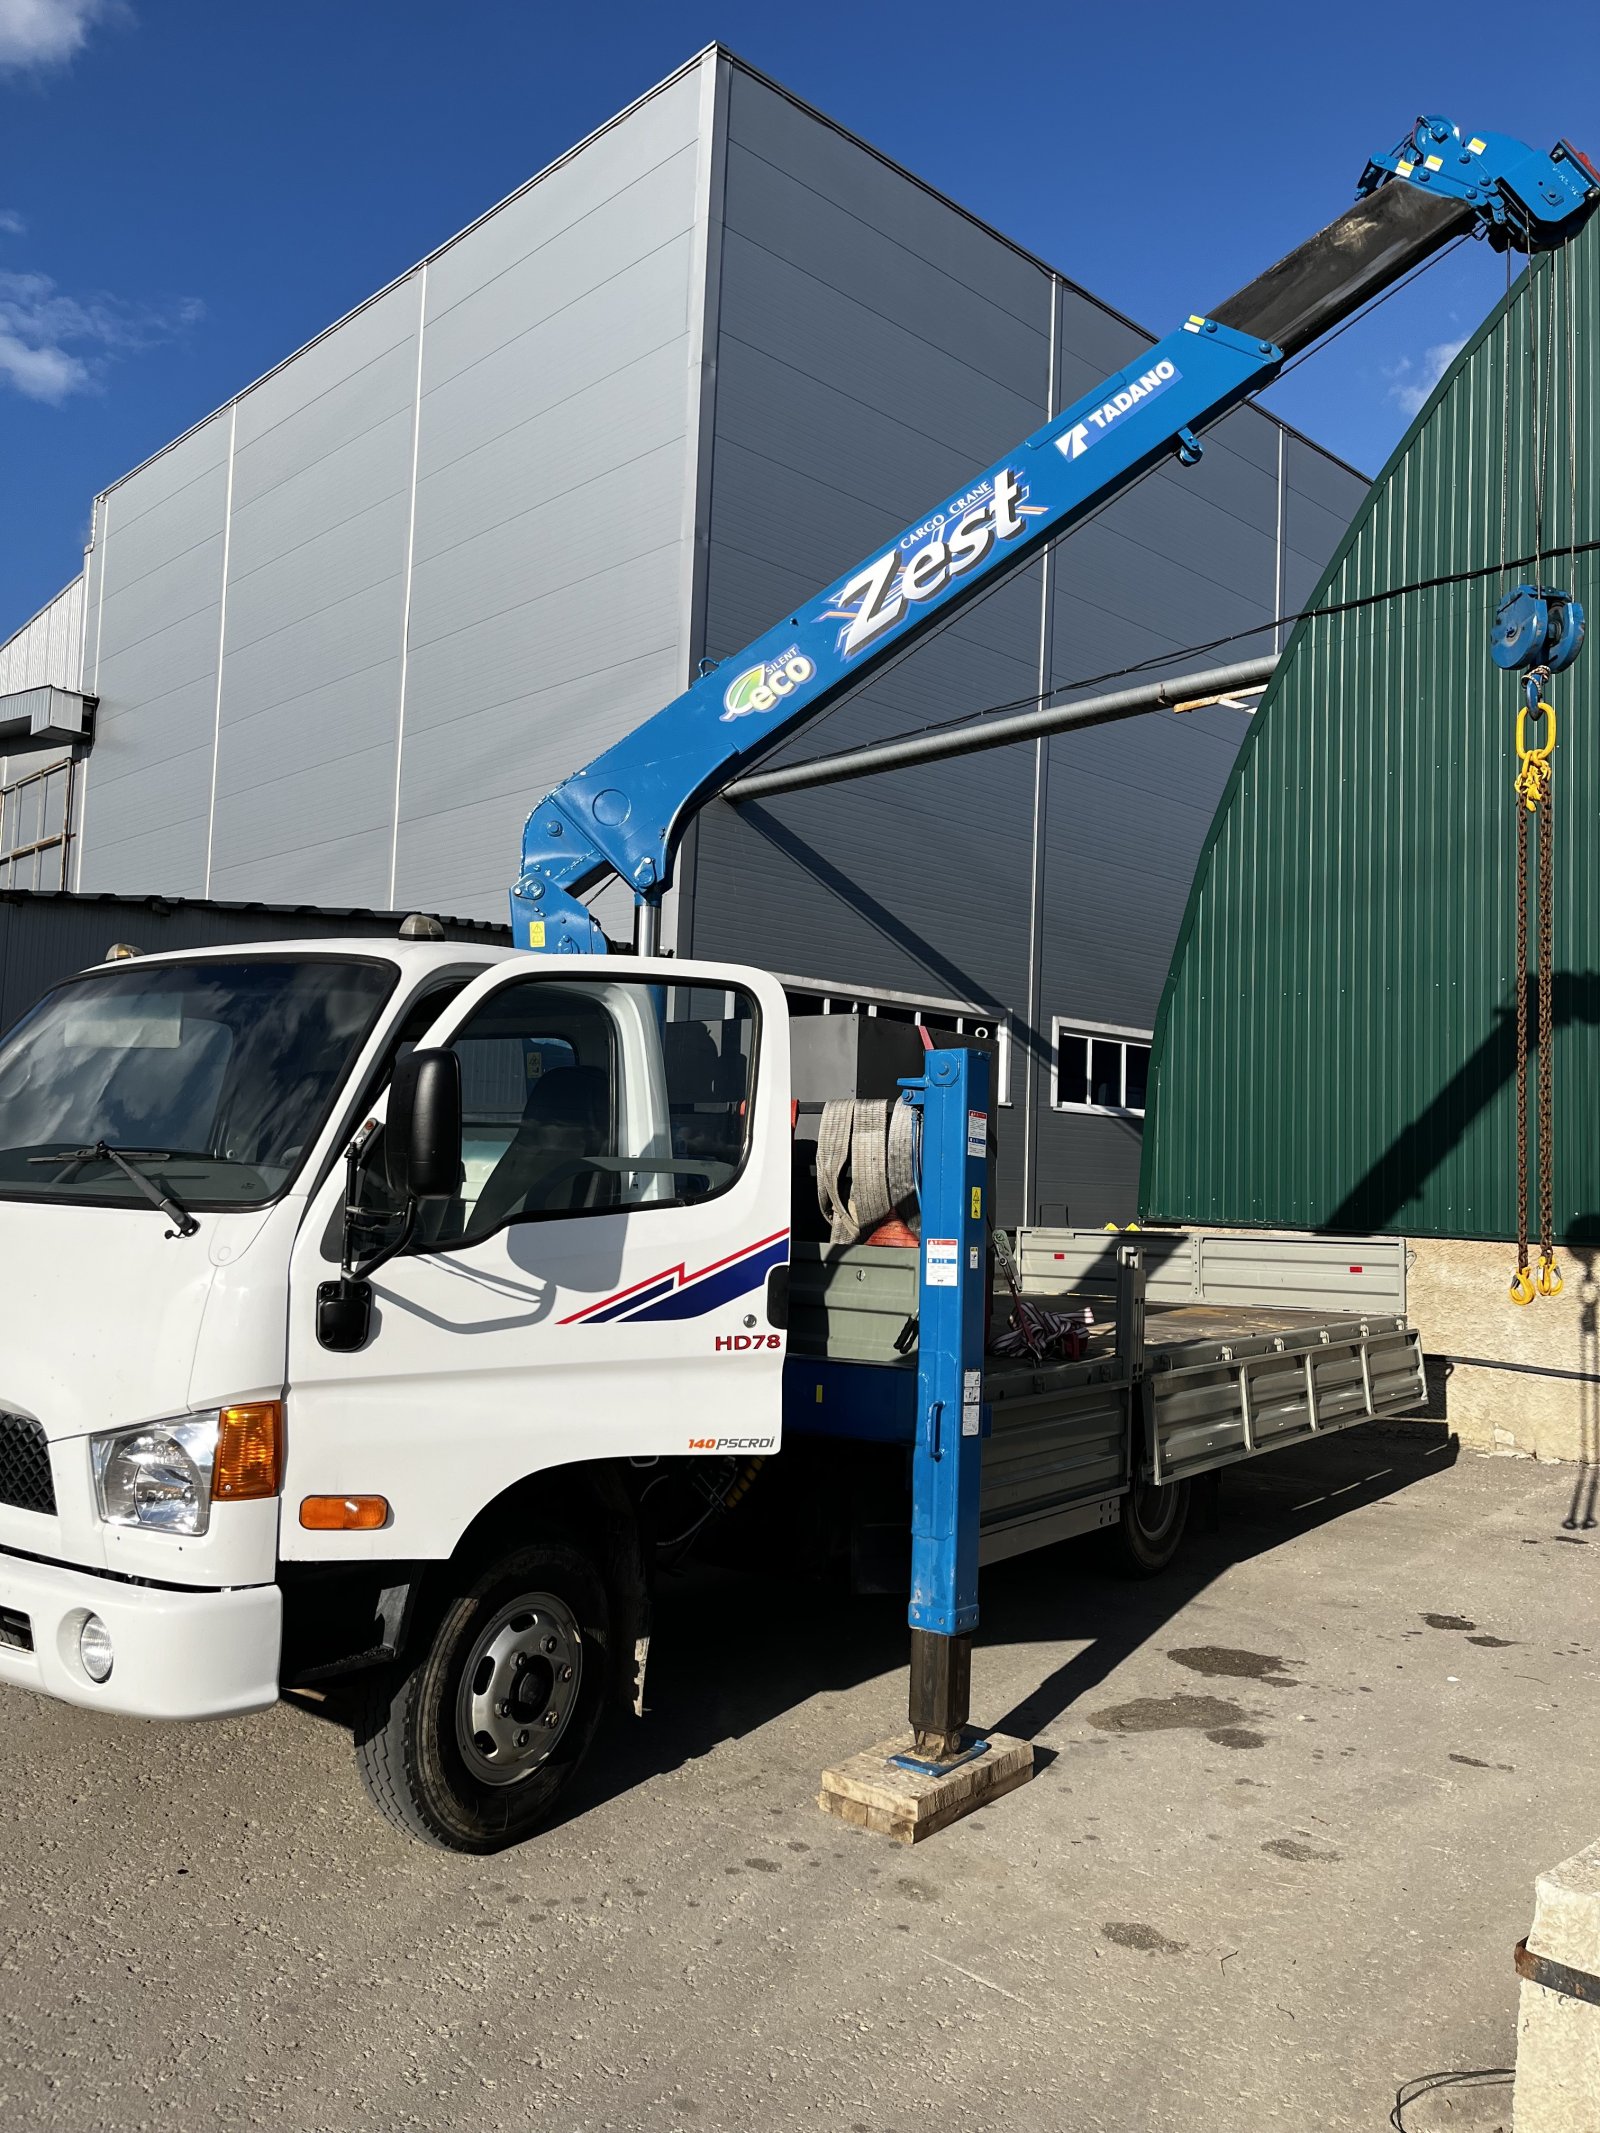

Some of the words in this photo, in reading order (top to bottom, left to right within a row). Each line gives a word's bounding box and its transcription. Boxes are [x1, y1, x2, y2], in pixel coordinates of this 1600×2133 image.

[1088, 361, 1175, 428] TADANO
[900, 514, 945, 549] CARGO
[949, 481, 993, 514] CRANE
[837, 468, 1023, 656] Zest
[749, 656, 812, 711] eco
[765, 647, 798, 675] SILENT
[715, 1334, 781, 1351] HD78
